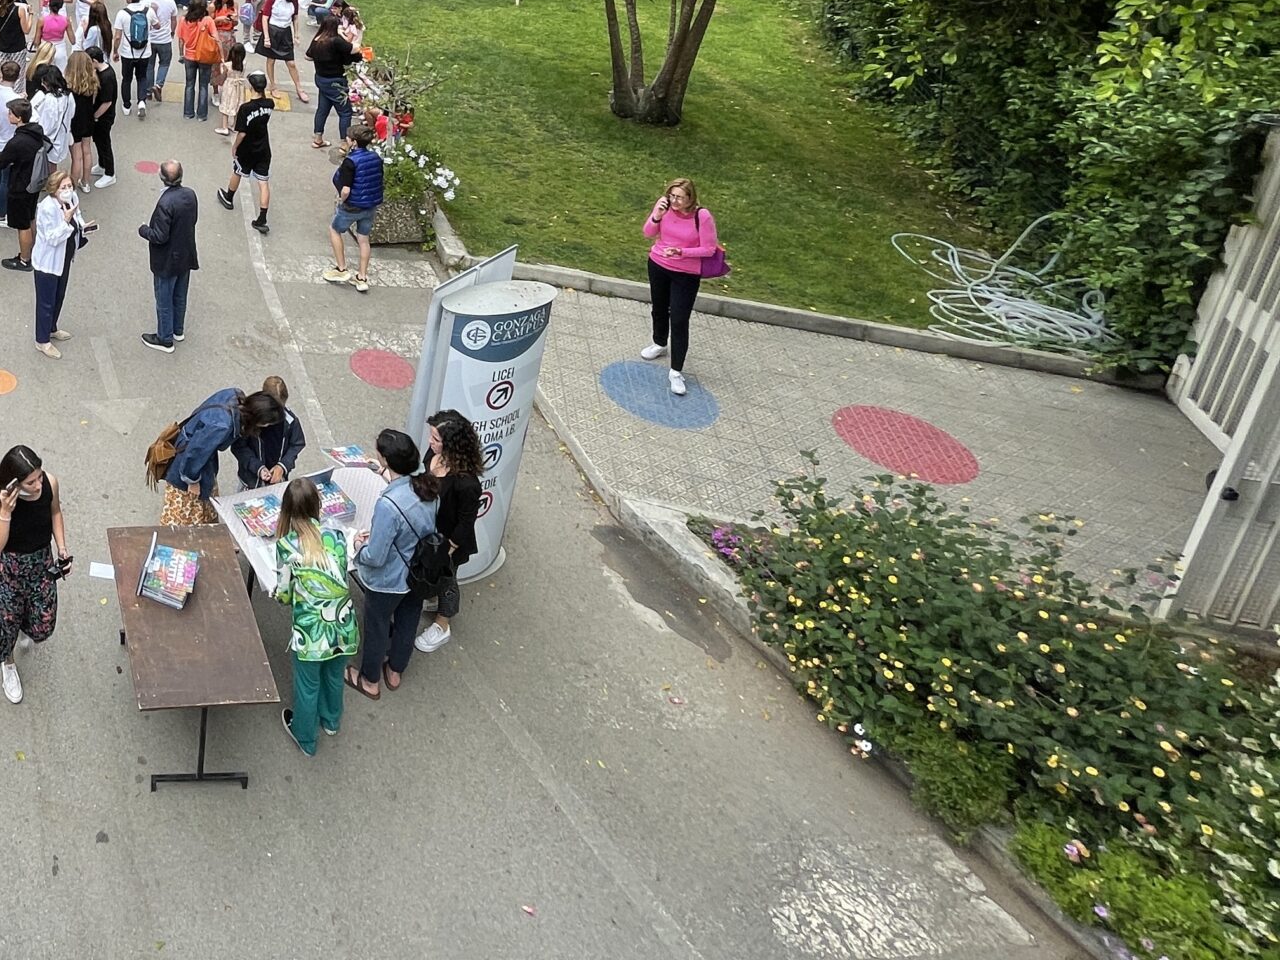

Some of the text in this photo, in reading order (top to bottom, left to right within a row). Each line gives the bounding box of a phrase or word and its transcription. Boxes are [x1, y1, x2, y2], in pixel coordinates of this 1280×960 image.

[492, 318, 546, 342] CAMPUS
[494, 307, 547, 331] GONZAGA
[492, 367, 515, 382] LICEI
[472, 408, 521, 432] GH SCHOOL
[480, 476, 498, 490] EDIE
